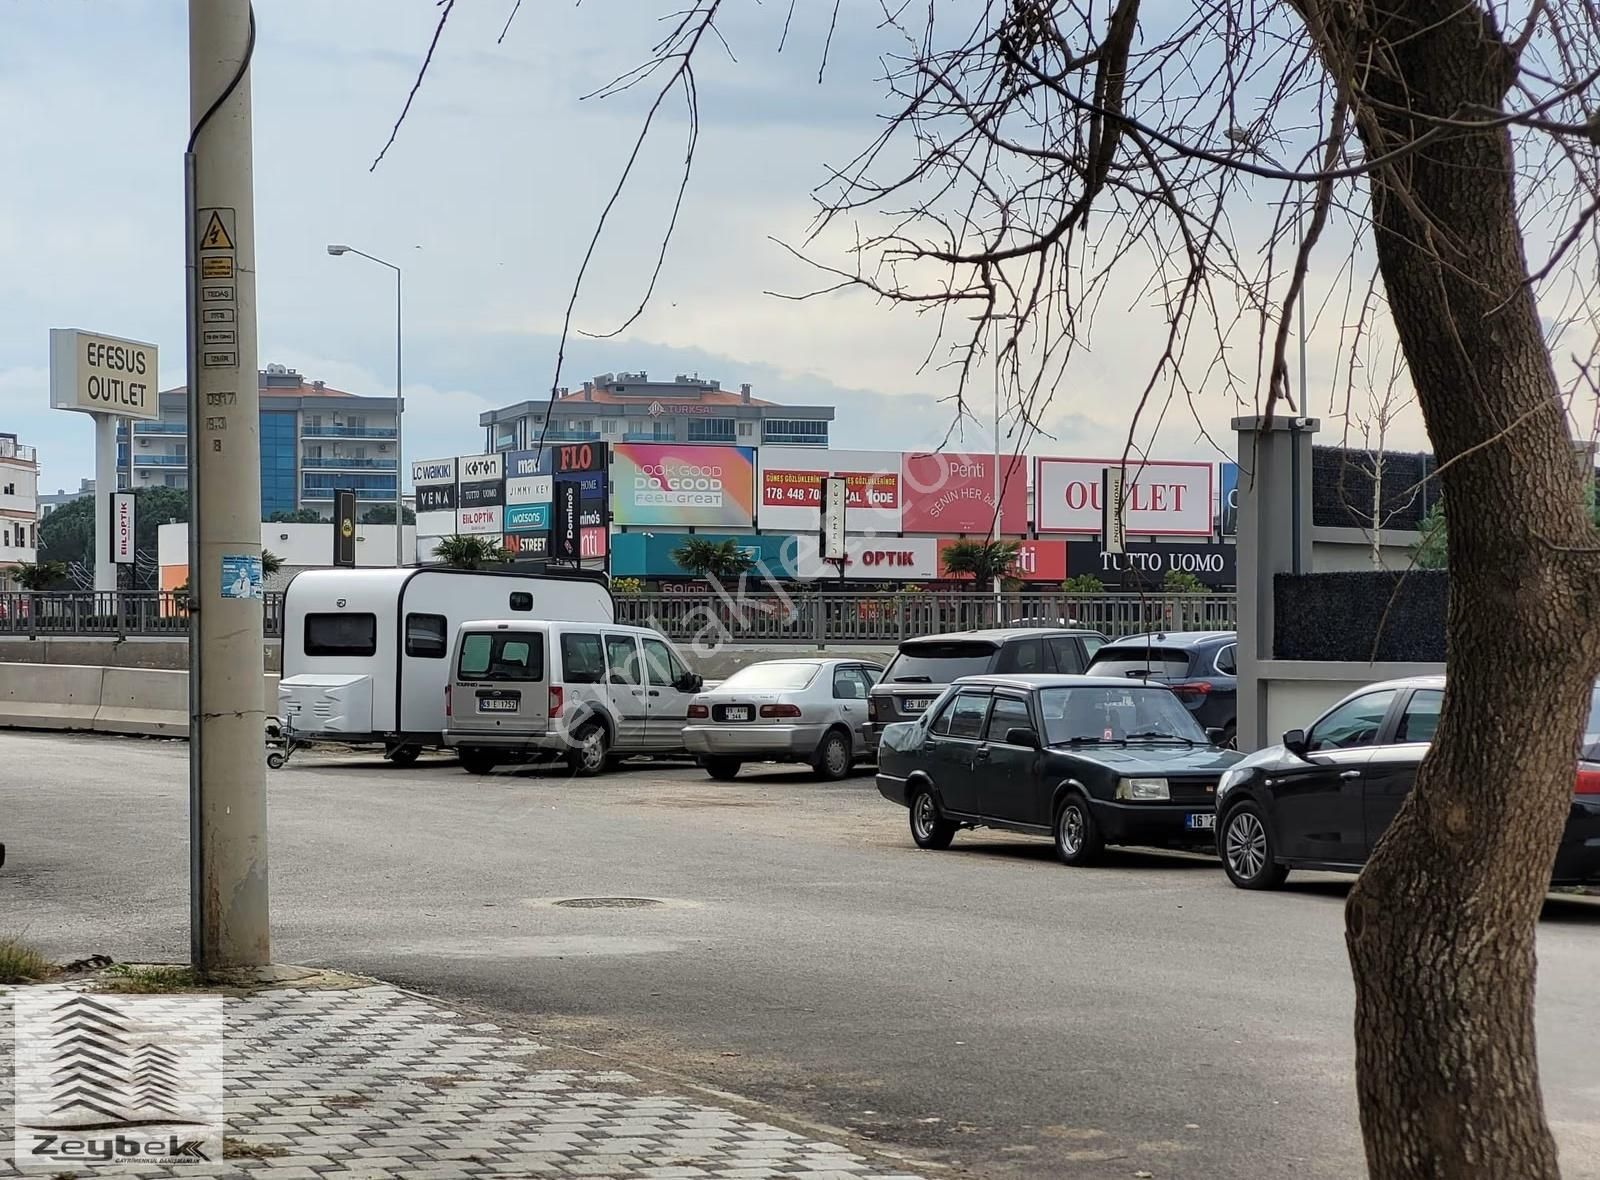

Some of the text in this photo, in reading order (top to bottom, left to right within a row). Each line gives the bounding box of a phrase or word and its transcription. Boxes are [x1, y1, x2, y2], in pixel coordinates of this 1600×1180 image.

[87, 342, 146, 375] EFESUS
[87, 375, 147, 408] OUTLET
[560, 444, 592, 470] FLO
[412, 466, 422, 480] LC
[634, 464, 722, 477] LOOK GOOD
[950, 462, 985, 478] Penti
[580, 479, 597, 490] HOME
[634, 477, 722, 490] DO GOOD
[784, 473, 821, 484] GÖZLÜKLERİN
[510, 484, 549, 496] JIMMY KEY
[808, 488, 821, 500] 70
[961, 487, 982, 499] HER
[1065, 481, 1188, 512] OULET
[421, 490, 449, 505] YENA
[512, 512, 540, 524] watsons
[505, 534, 520, 552] IN
[520, 538, 547, 552] STREET
[581, 529, 598, 556] nti
[1168, 553, 1224, 572] UOMO
[1192, 815, 1203, 827] 16
